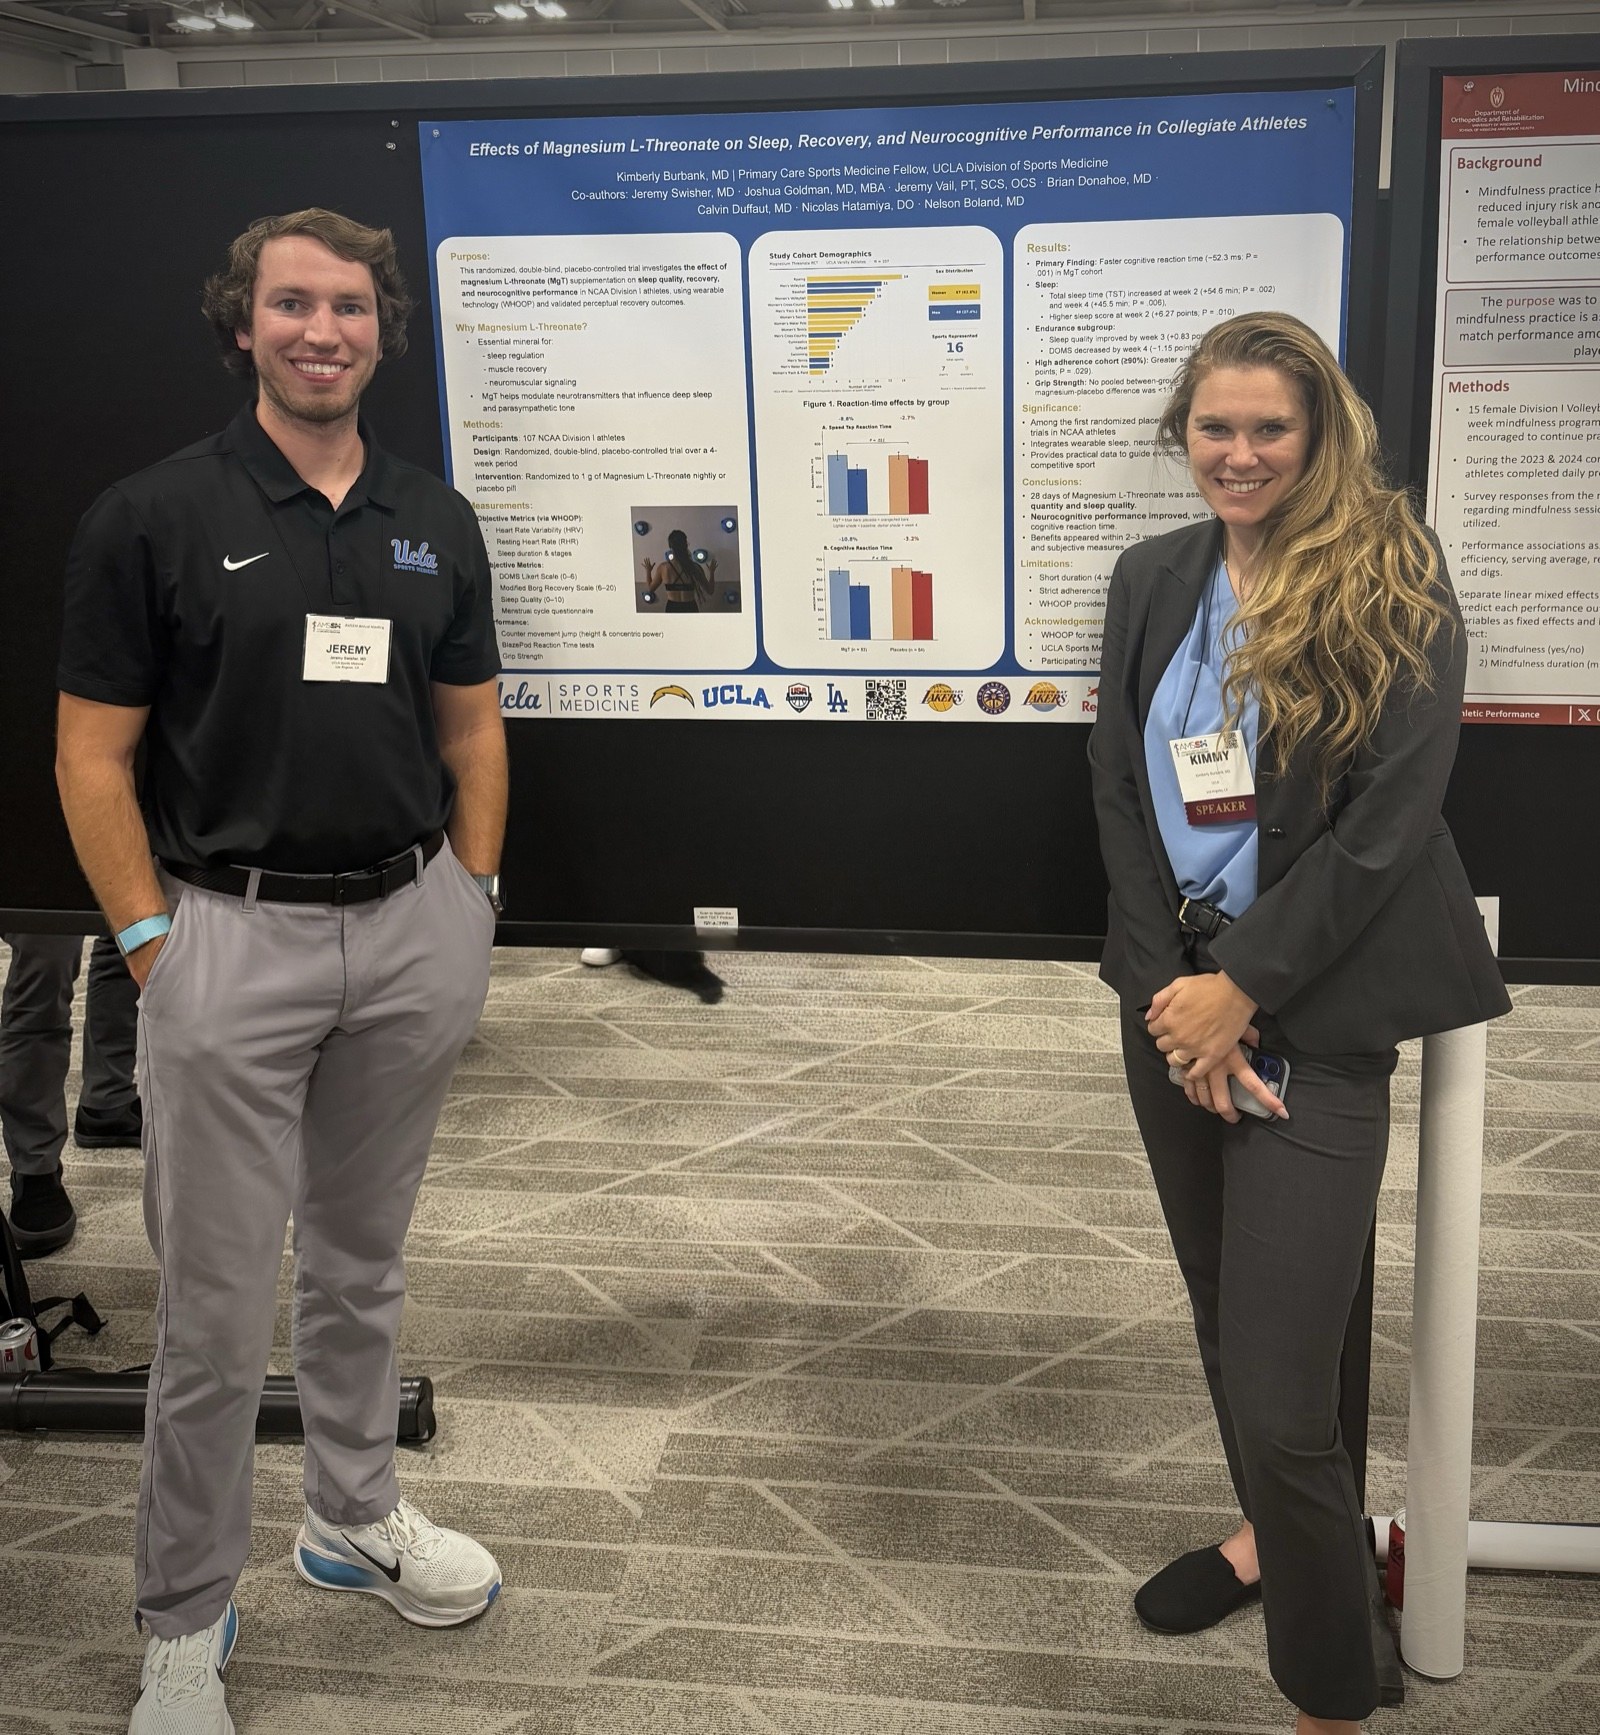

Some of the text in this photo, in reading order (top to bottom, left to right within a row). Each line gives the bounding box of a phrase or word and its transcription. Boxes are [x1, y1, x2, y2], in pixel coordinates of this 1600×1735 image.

[470, 116, 1306, 156] Effects of Magnesium L-Threonate on Sleep, Recovery, and Neurocognitive Performance in Collegiate Athletes
[1458, 155, 1542, 170] Background
[616, 158, 1108, 182] Kimberly Burbank, MD Primary Care Sports Medicine Fellow, UCLA Division of Sports Medicine
[571, 173, 1151, 199] Co-authors: Jeremy Swisher, MD Joshua Goldman, MD, MBA Jeremy Vail, PT, SCS, OCS Brian Donahoe, MD
[1478, 184, 1591, 195] Mindfulness practice
[697, 196, 1024, 214] Calvin Duffaut, MD Nicolas Hatamiya, DO Nelson Boland, MD
[1478, 200, 1578, 212] reduced injury risk
[1476, 235, 1563, 245] The relationship
[1027, 243, 1070, 252] Results:
[450, 252, 489, 261] Purpose:
[819, 251, 872, 259] Demographics
[1035, 260, 1065, 268] Primary
[455, 323, 474, 333] Why
[478, 323, 527, 332] Magnesium
[947, 342, 964, 353] 16
[1448, 380, 1509, 392] Methods
[1022, 404, 1080, 413] Significance:
[1469, 405, 1479, 413] 15
[1482, 404, 1516, 413] female
[1031, 427, 1049, 436] trials
[1466, 456, 1497, 465] During
[1548, 454, 1554, 463] &
[1559, 455, 1582, 464] 2024
[391, 539, 438, 569] Ucla
[326, 644, 371, 655] JEREMY
[559, 684, 639, 697] SPORTS
[790, 687, 807, 696] USA
[702, 684, 770, 709] UCLA
[827, 683, 848, 712] LA
[920, 689, 965, 706] LAKERS
[1021, 690, 1069, 707] LAKERS
[560, 700, 639, 712] MEDICINE
[1082, 701, 1097, 712] Re
[1486, 710, 1540, 718] Performance
[1190, 750, 1229, 766] KIMMY
[1196, 800, 1247, 816] SPEAKER
